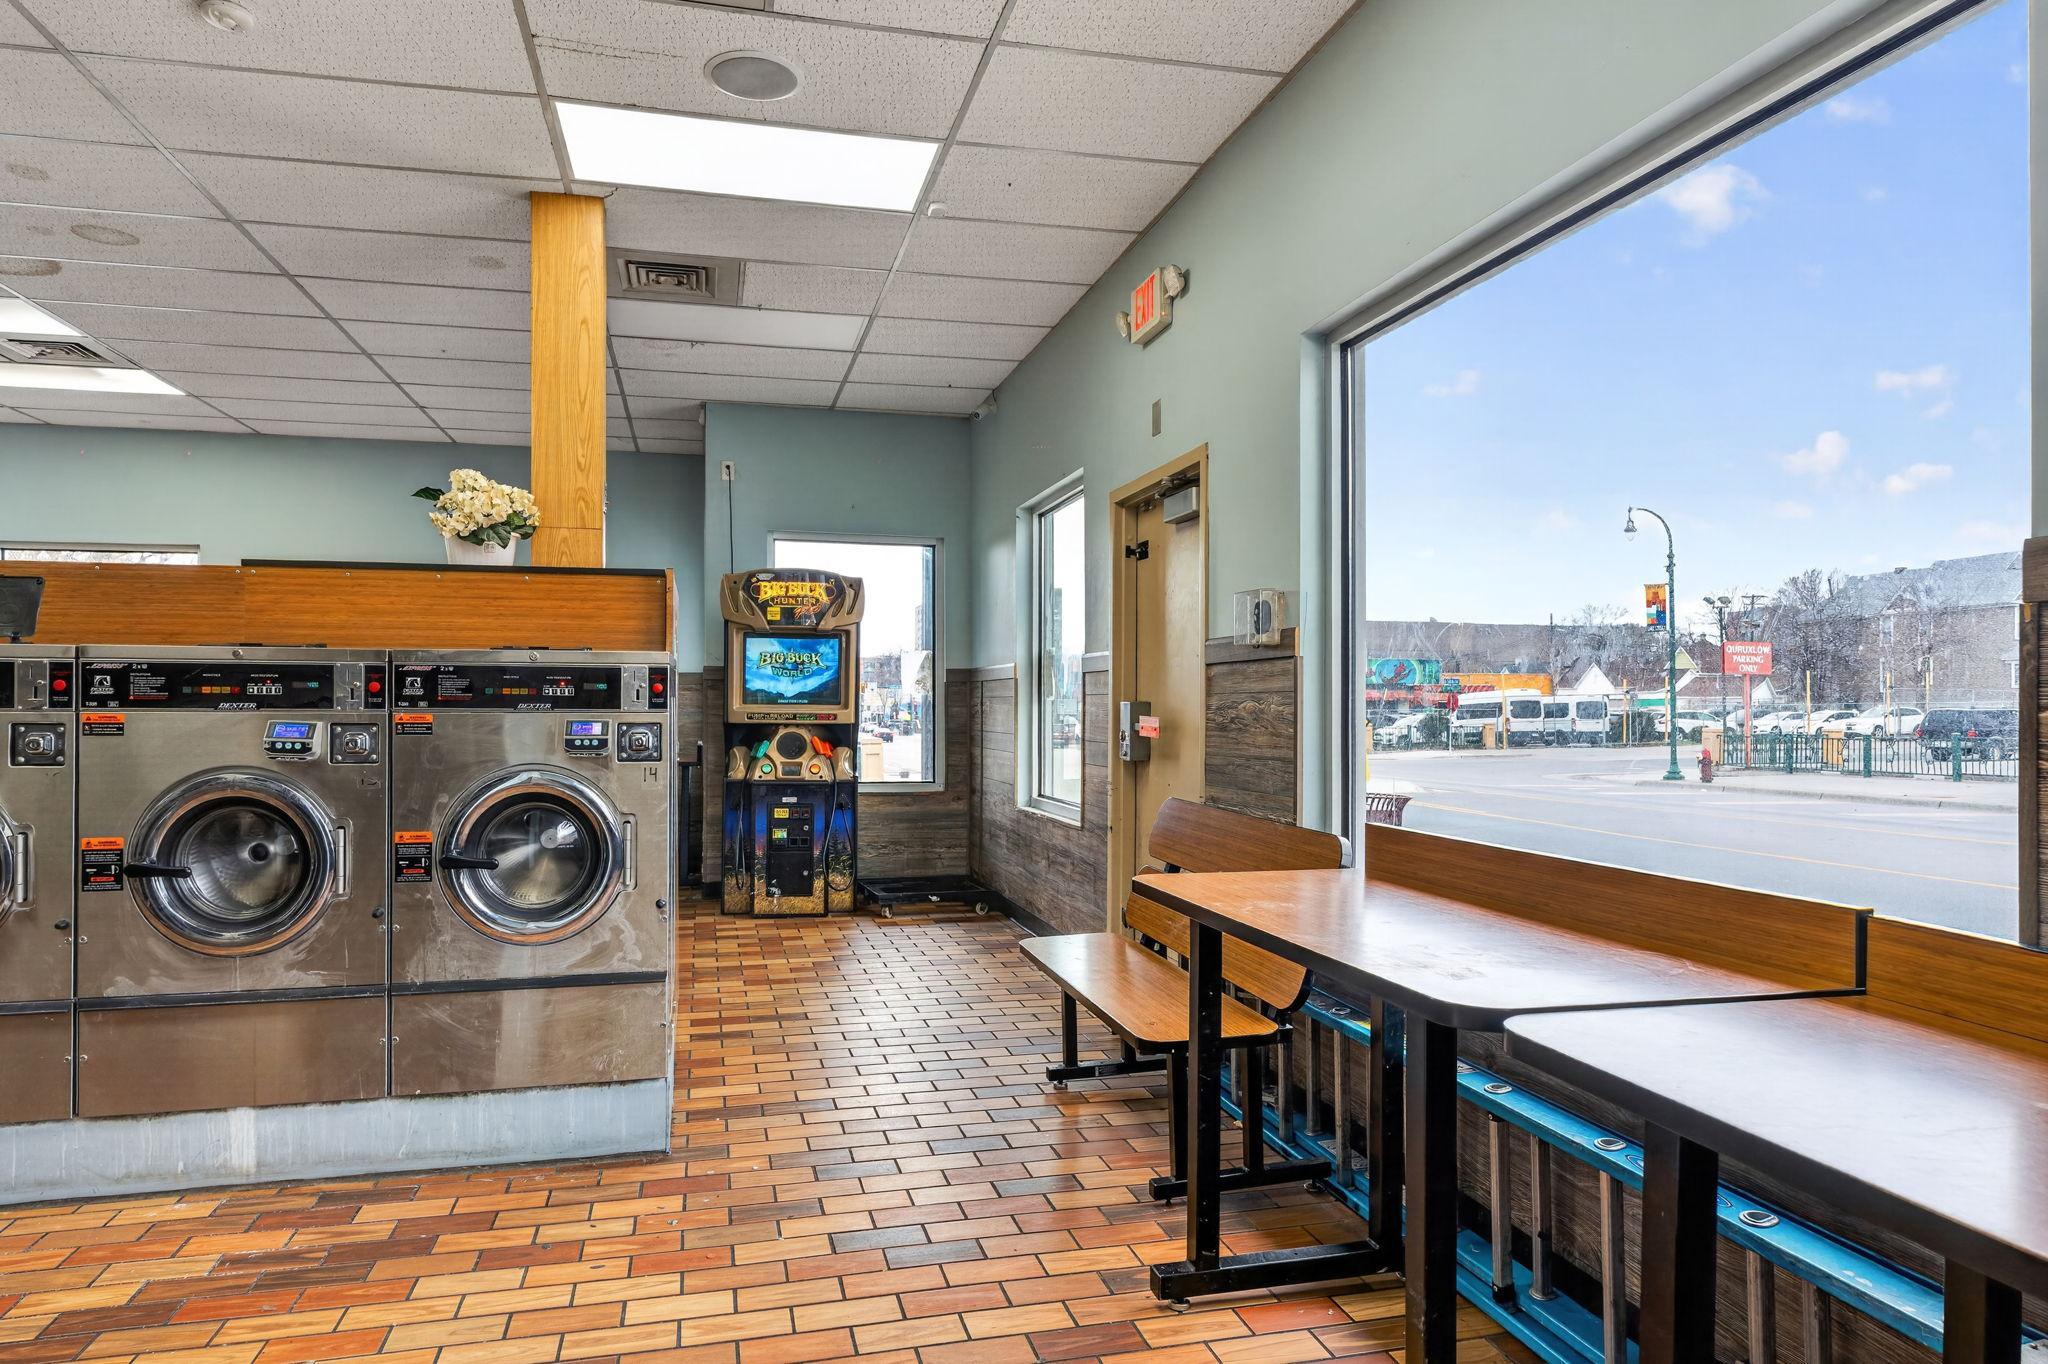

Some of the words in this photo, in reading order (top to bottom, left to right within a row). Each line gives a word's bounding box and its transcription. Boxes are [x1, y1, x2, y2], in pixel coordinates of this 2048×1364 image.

[1135, 273, 1156, 332] EXIT
[758, 581, 787, 603] BIG
[788, 581, 830, 603] BUCK
[1726, 645, 1771, 654] QURUXLOW
[758, 651, 785, 669] BIG
[786, 650, 827, 669] BUCK
[1732, 655, 1764, 663] PARKING
[771, 665, 813, 678] WORLD
[1739, 664, 1758, 672] ONLY
[643, 767, 658, 782] 14
